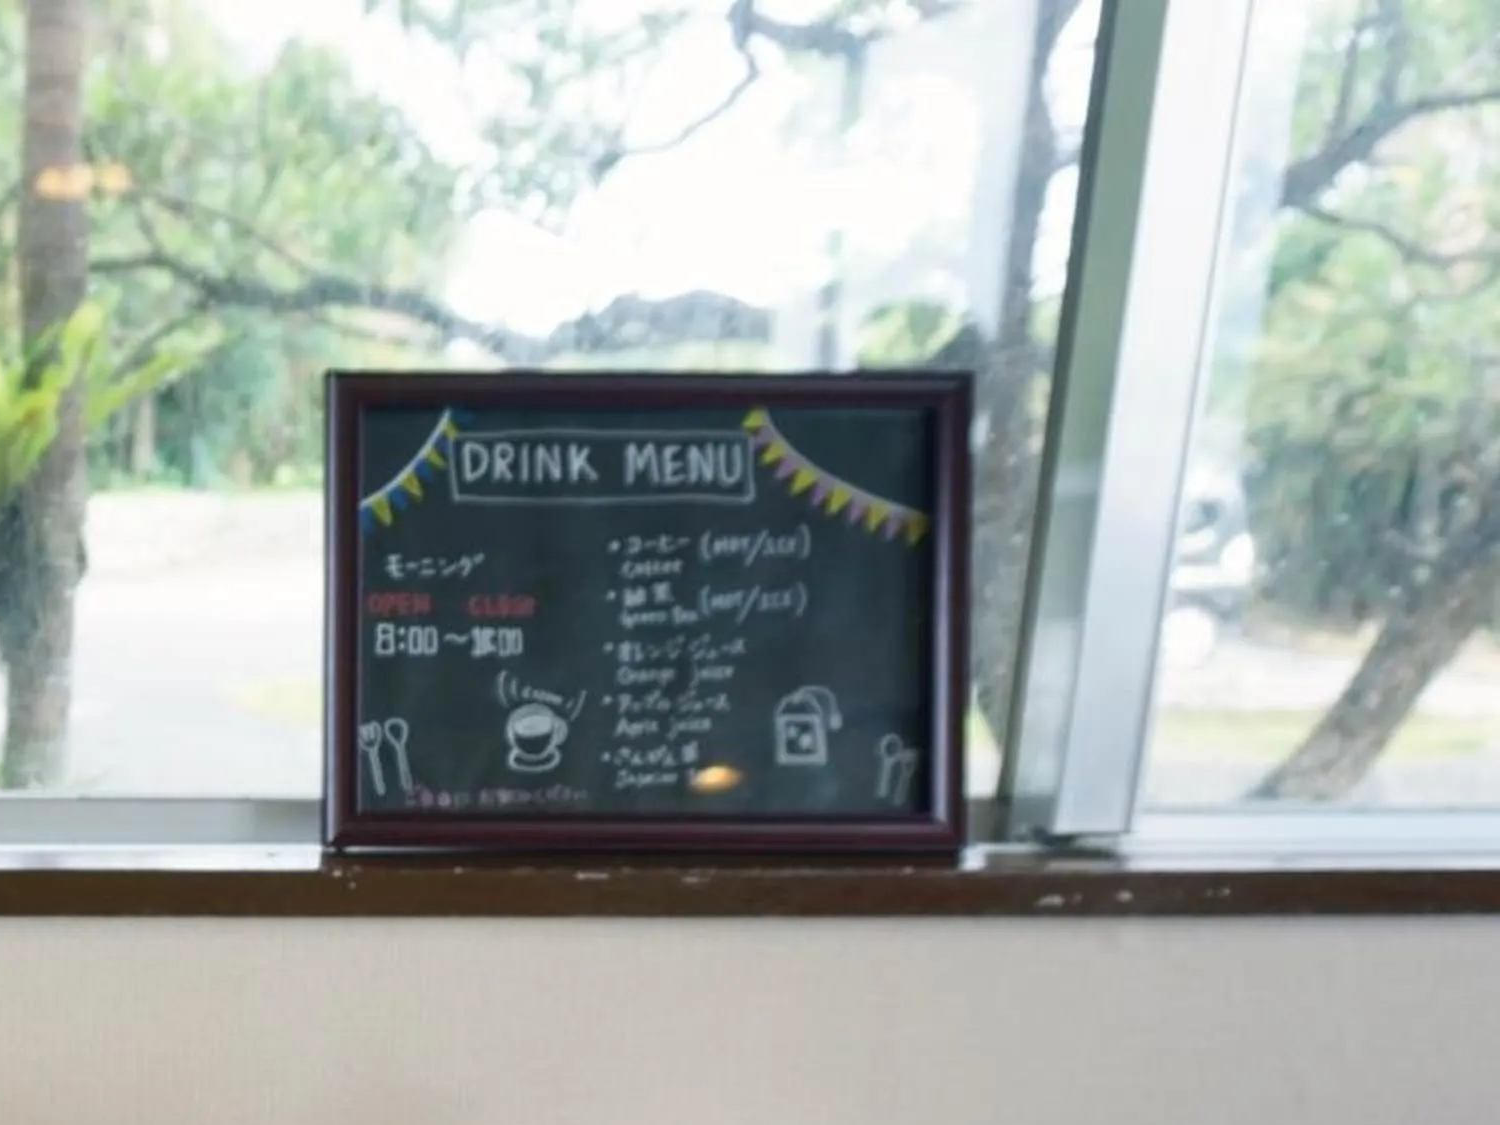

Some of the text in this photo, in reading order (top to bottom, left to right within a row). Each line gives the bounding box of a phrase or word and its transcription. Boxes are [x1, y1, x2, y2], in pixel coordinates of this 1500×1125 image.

[461, 441, 743, 487] DRINK MENU
[384, 552, 485, 579] モーニング
[367, 593, 432, 615] OPEN
